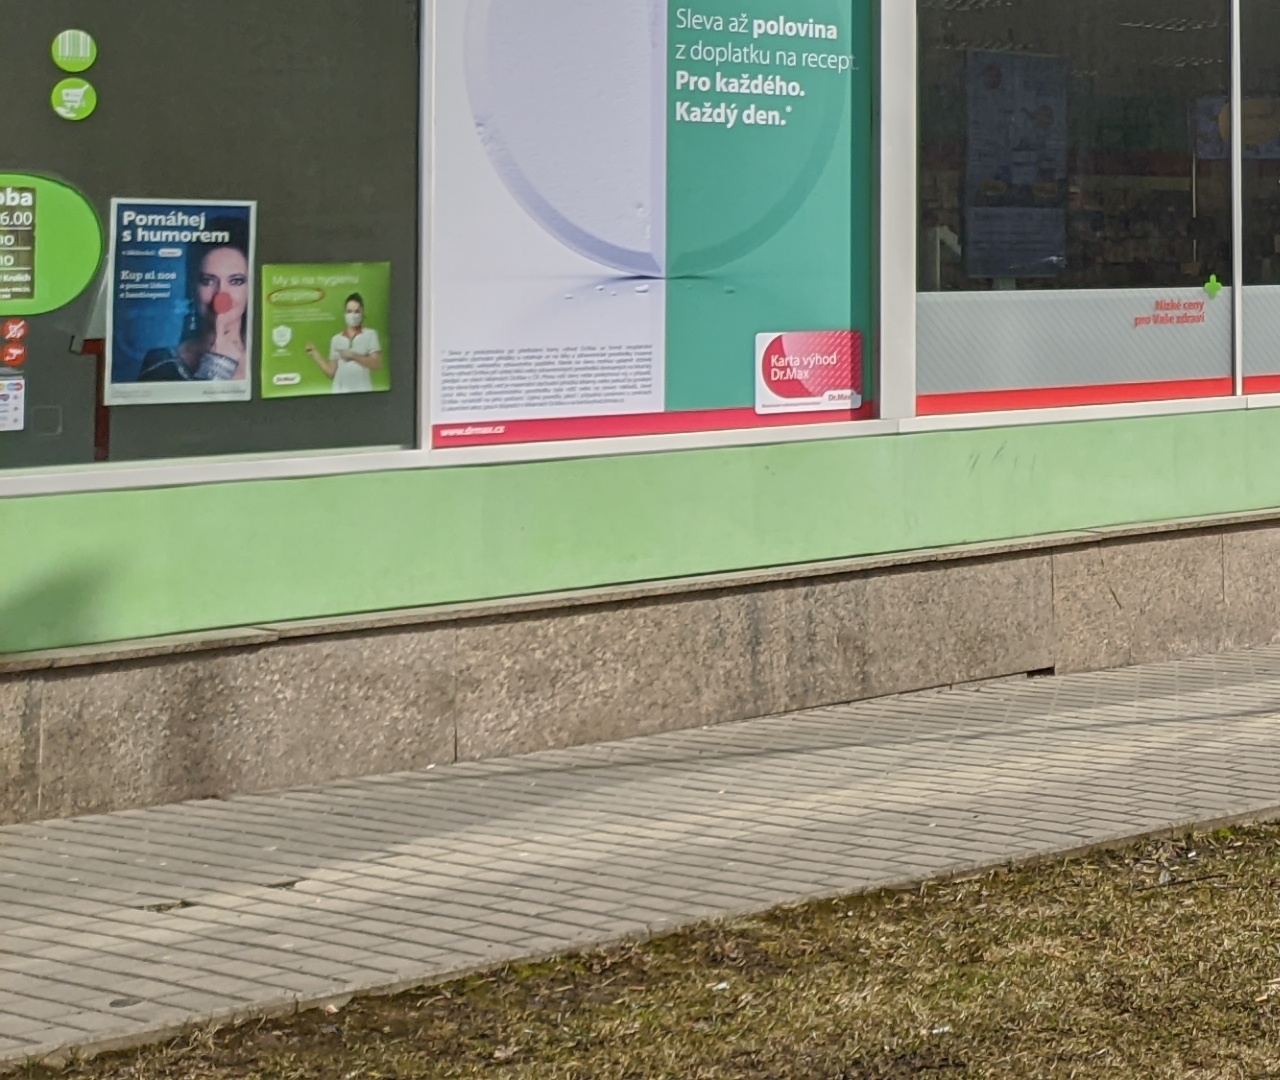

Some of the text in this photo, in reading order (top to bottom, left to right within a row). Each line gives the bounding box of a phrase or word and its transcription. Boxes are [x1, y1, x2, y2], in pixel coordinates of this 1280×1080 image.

[676, 8, 838, 39] Sleva až polovina
[675, 40, 860, 74] z doplatku na recept.
[675, 70, 806, 96] Pro každého.
[675, 101, 738, 128] Každý
[122, 210, 206, 230] Pomáhej
[121, 228, 230, 242] s humorem
[120, 270, 177, 282] Kup si nos
[771, 352, 837, 368] Karta výhod
[771, 368, 809, 381] Dr.Max
[828, 393, 851, 402] Dr.Max
